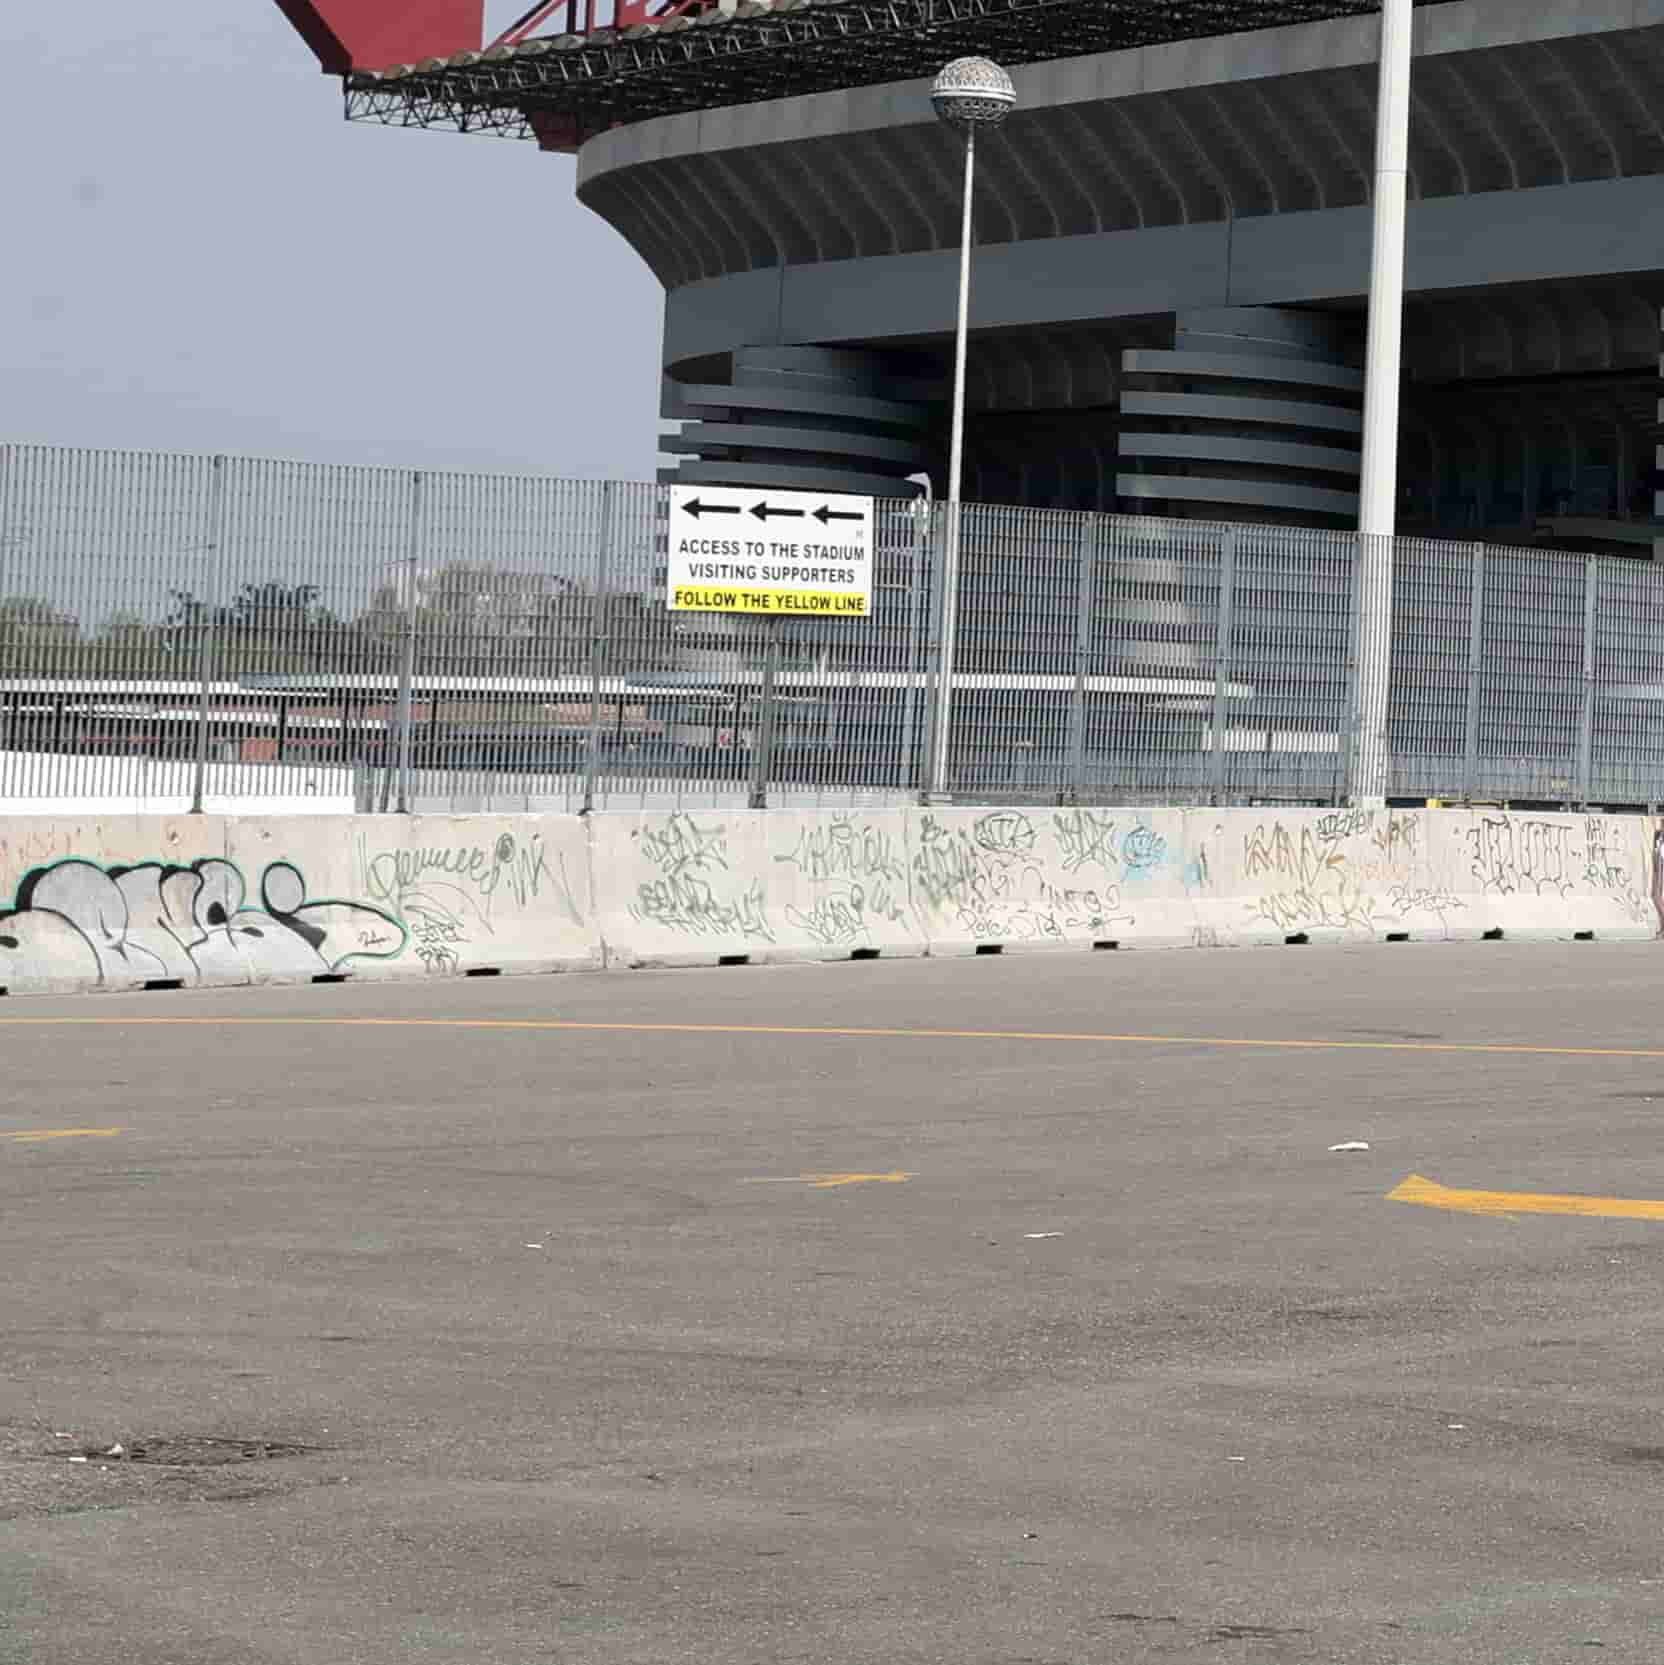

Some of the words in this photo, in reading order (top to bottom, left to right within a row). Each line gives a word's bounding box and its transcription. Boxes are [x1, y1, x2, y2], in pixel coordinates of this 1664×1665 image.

[679, 538, 741, 556] ACCESS
[744, 541, 765, 557] TO
[769, 542, 800, 559] THE
[803, 543, 865, 561] STADIUM
[688, 562, 757, 580] VISITING
[761, 565, 855, 584] SUPPORTERS
[674, 590, 737, 607] FOLLOW
[741, 593, 770, 609] THE
[775, 594, 832, 611] YELLOW
[834, 597, 865, 612] LINE
